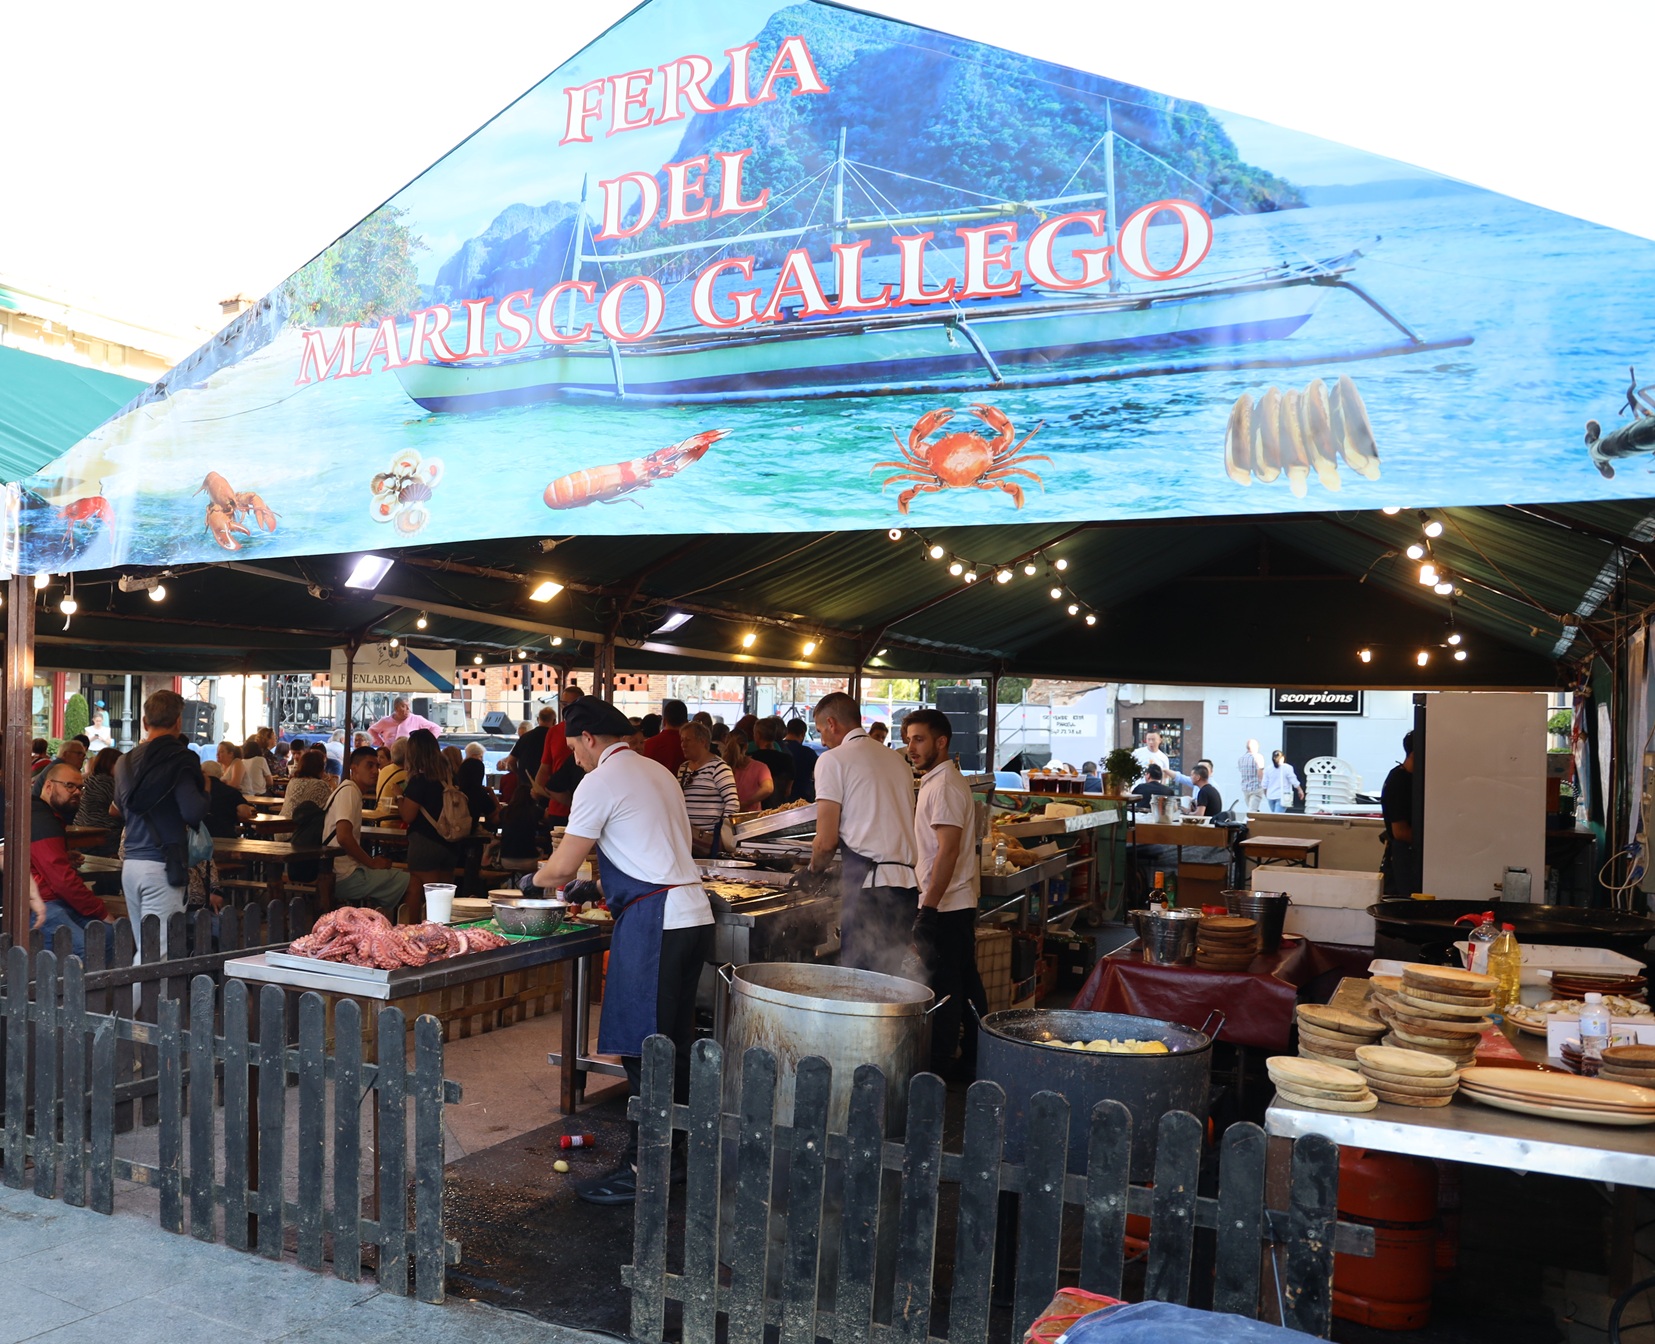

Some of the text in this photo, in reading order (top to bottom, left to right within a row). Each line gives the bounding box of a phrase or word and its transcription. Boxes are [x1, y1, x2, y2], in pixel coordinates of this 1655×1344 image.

[559, 35, 830, 145] FERIA
[594, 149, 769, 242] DEL
[296, 199, 1213, 385] MARISCO GALLEGO
[340, 673, 412, 685] FENLABRADA
[1279, 691, 1354, 705] scorpions
